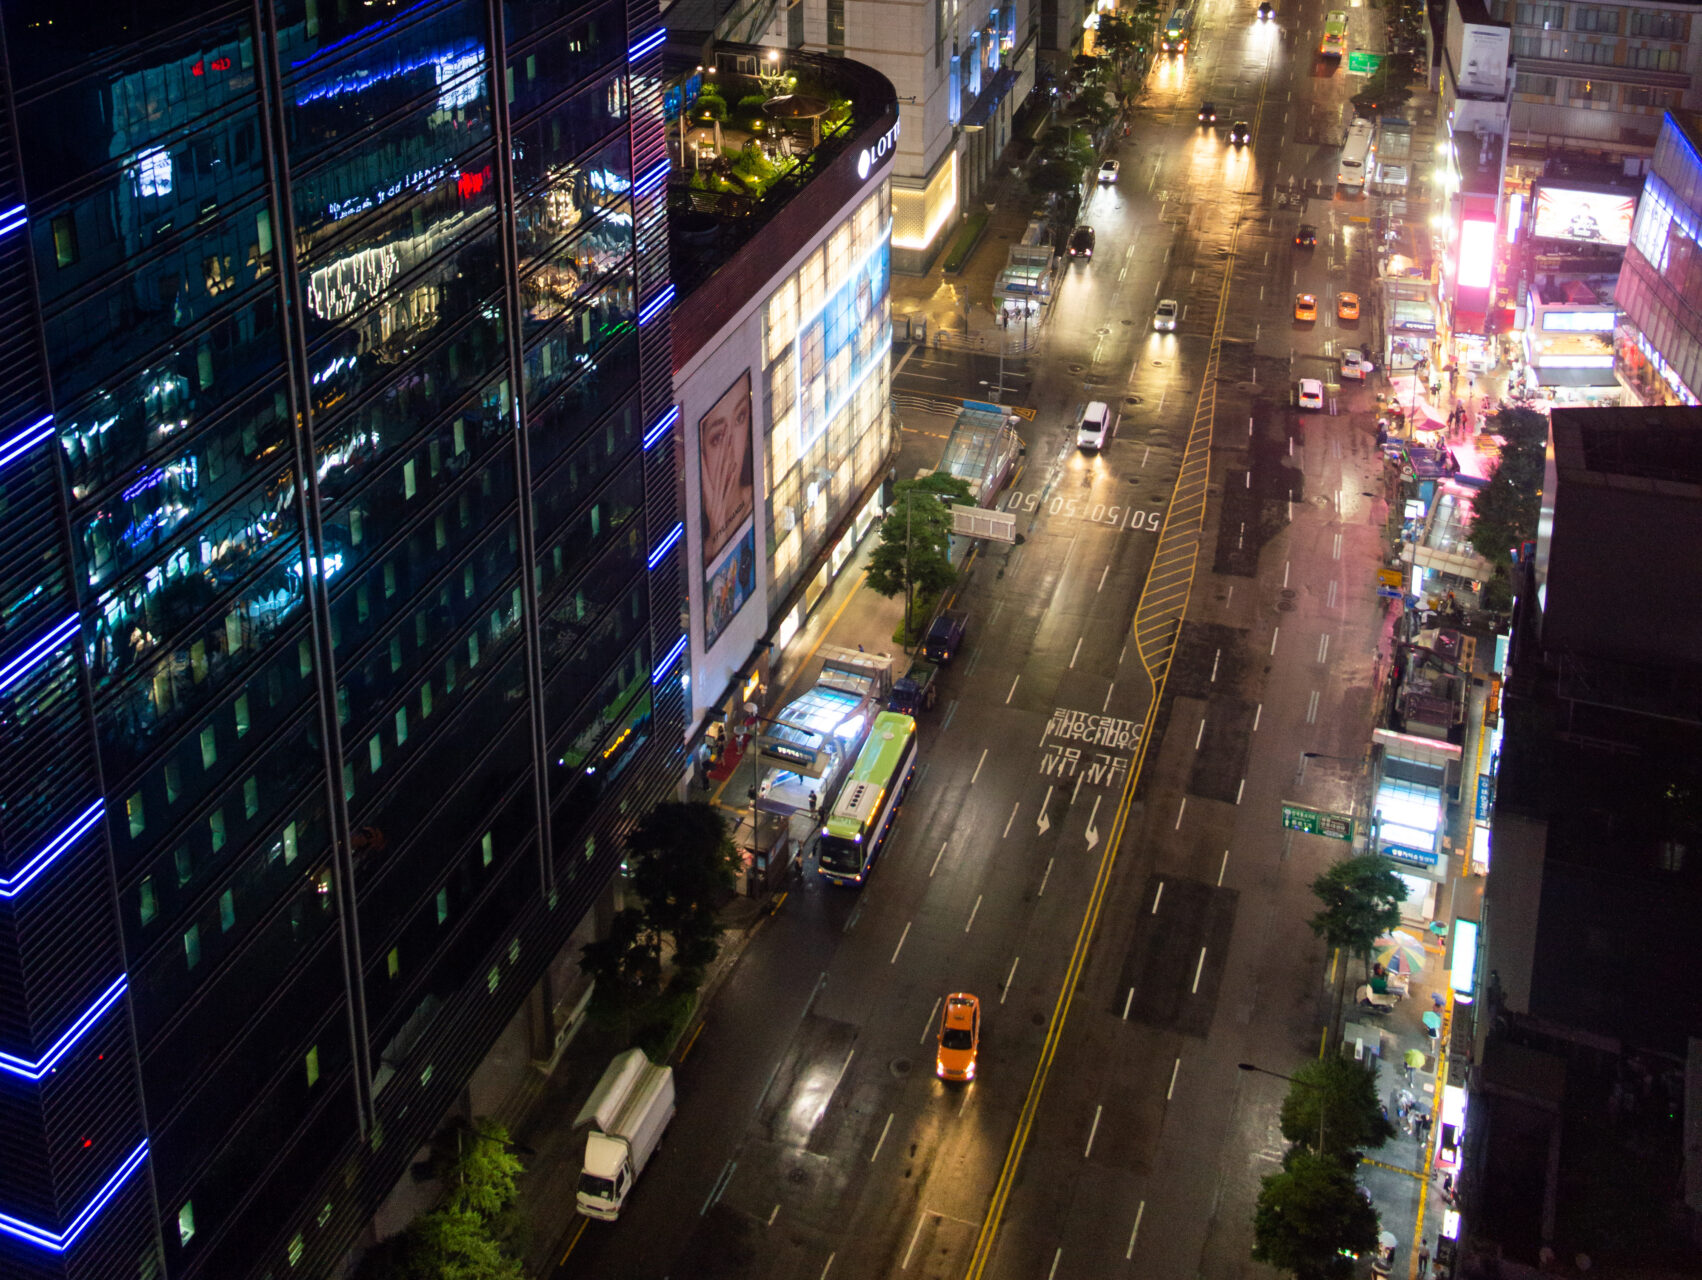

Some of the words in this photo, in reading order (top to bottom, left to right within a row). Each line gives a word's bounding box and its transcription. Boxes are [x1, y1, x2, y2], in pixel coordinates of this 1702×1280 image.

[1008, 491, 1038, 512] 50
[1050, 497, 1080, 517] 50
[1091, 504, 1120, 525] 50
[1131, 510, 1161, 532] 50
[1039, 744, 1081, 778] 남산
